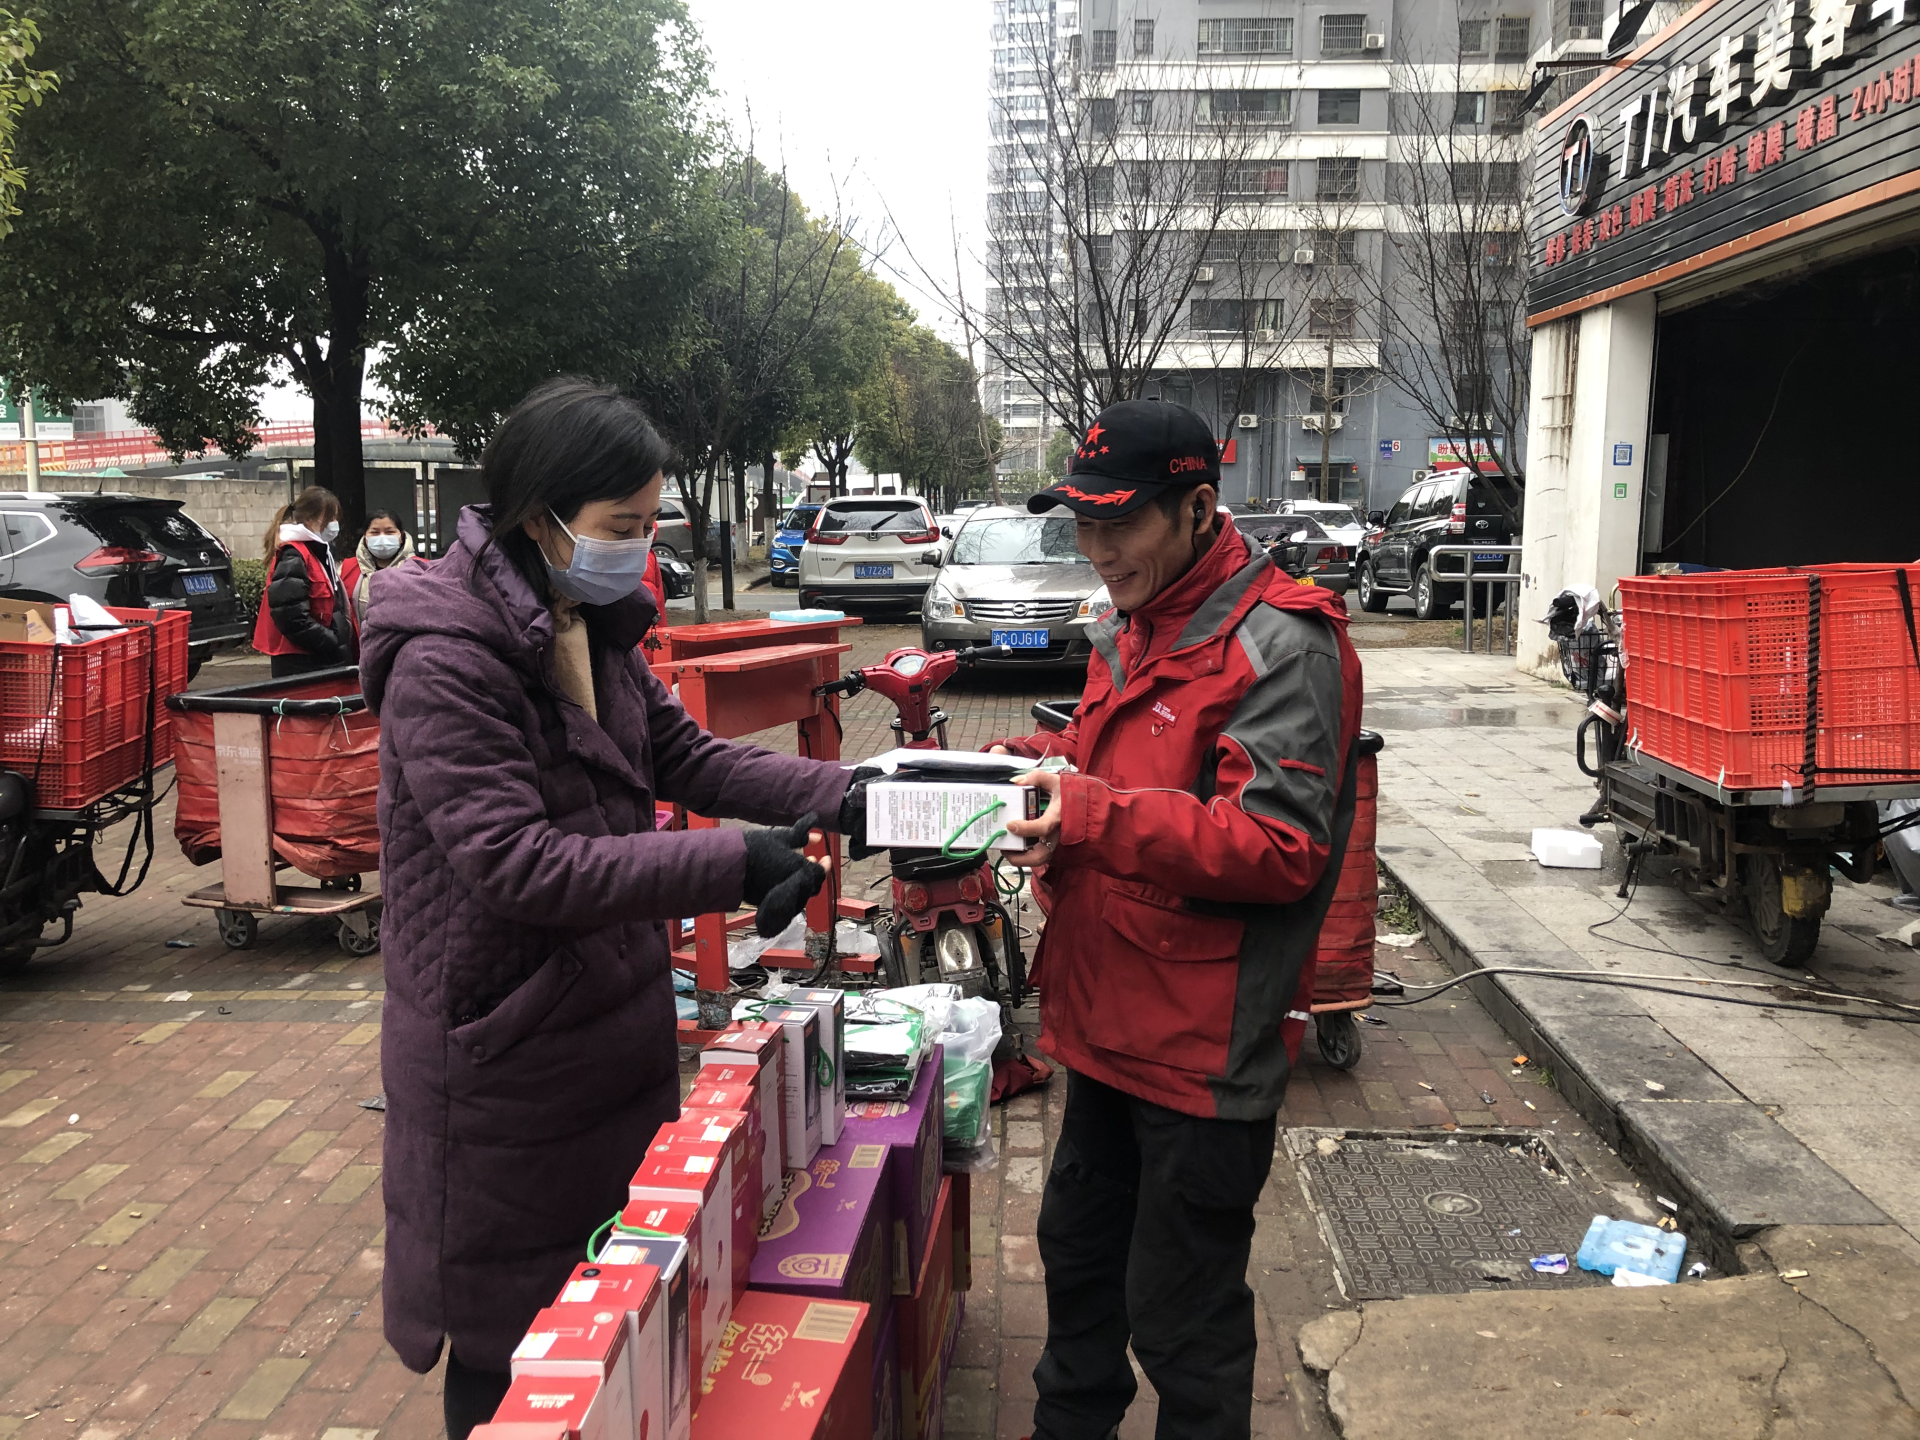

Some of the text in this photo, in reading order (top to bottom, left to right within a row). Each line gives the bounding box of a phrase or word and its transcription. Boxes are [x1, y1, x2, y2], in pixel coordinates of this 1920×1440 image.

[1545, 232, 1568, 267] 维修
[1571, 217, 1595, 256] 保养
[1598, 204, 1623, 242] 改色
[1629, 184, 1658, 229] 贴膜
[1664, 167, 1695, 213] 精洗
[1703, 145, 1739, 195] 打蜡
[1747, 120, 1786, 174] 镀膜
[1796, 94, 1839, 151] 镀晶
[1169, 456, 1208, 474] CHINA
[739, 1322, 789, 1381] 统一
